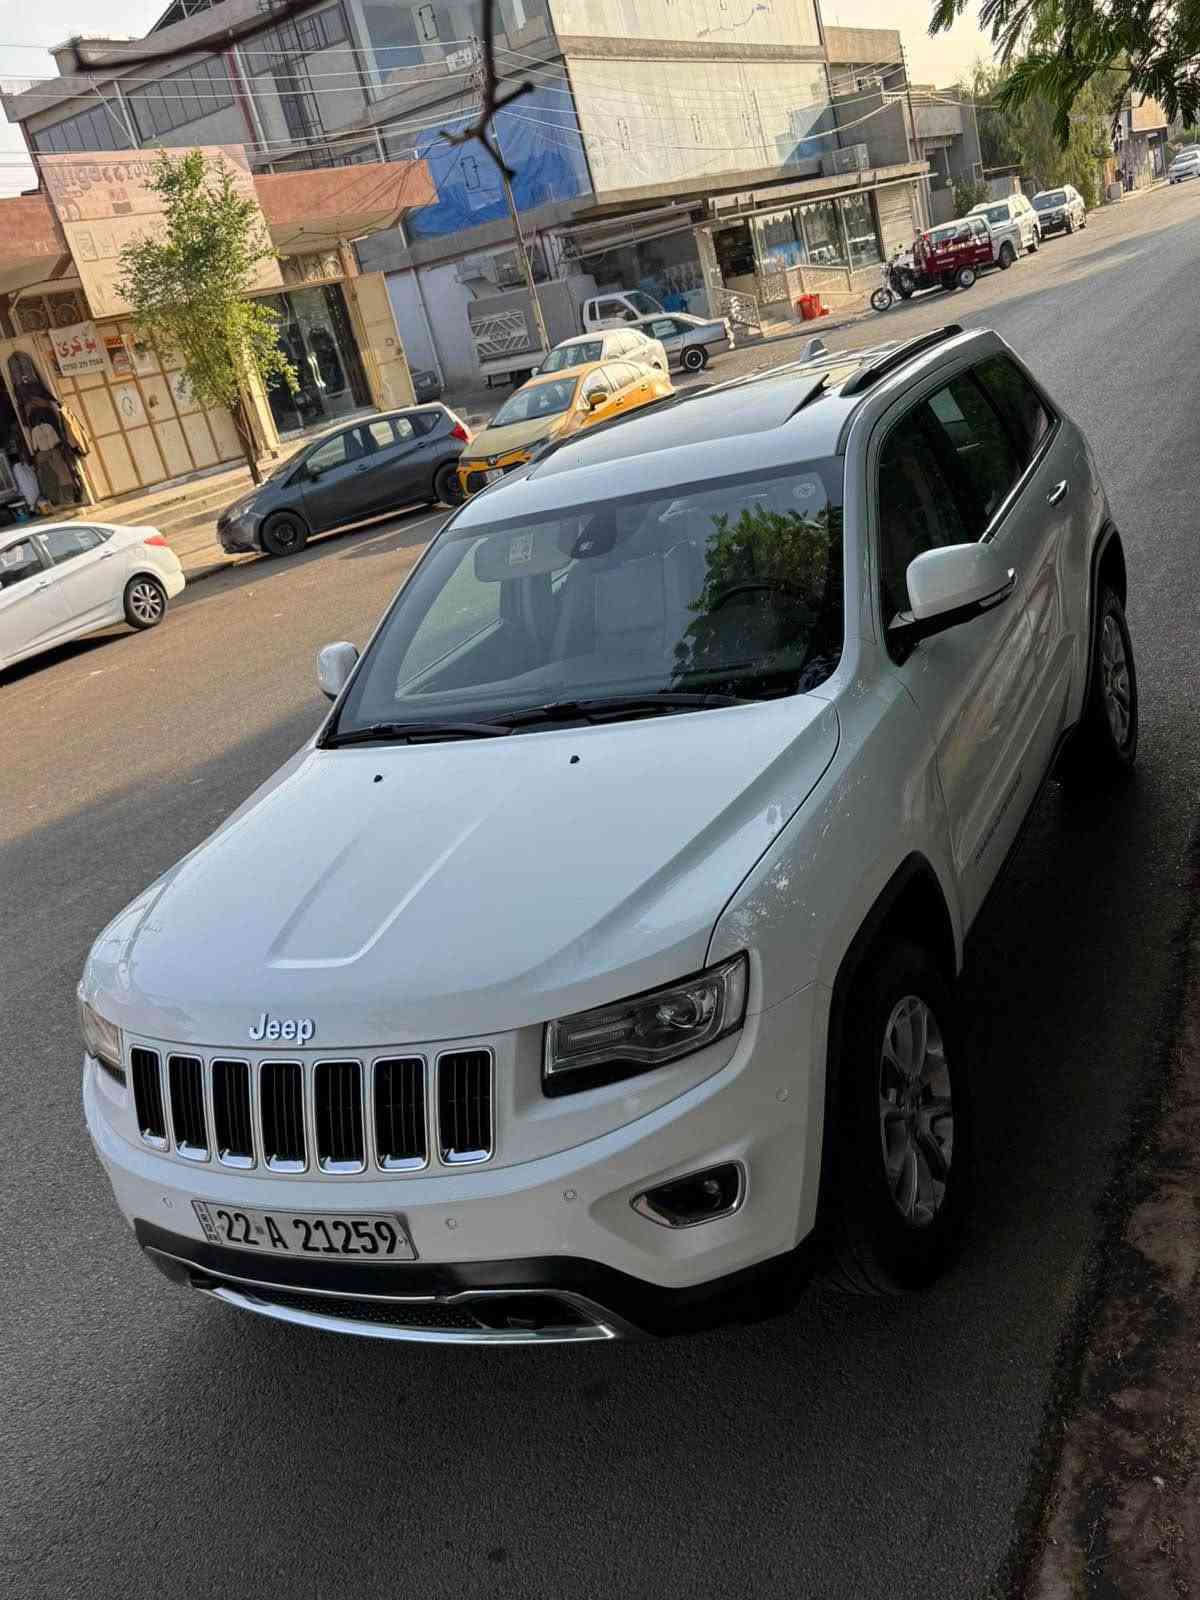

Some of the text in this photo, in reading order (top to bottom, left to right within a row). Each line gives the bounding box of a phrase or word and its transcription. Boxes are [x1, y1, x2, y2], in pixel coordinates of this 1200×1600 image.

[249, 1013, 315, 1046] Jeep
[217, 1210, 259, 1245] 22
[264, 1215, 289, 1249] A
[292, 1218, 397, 1254] 21259
